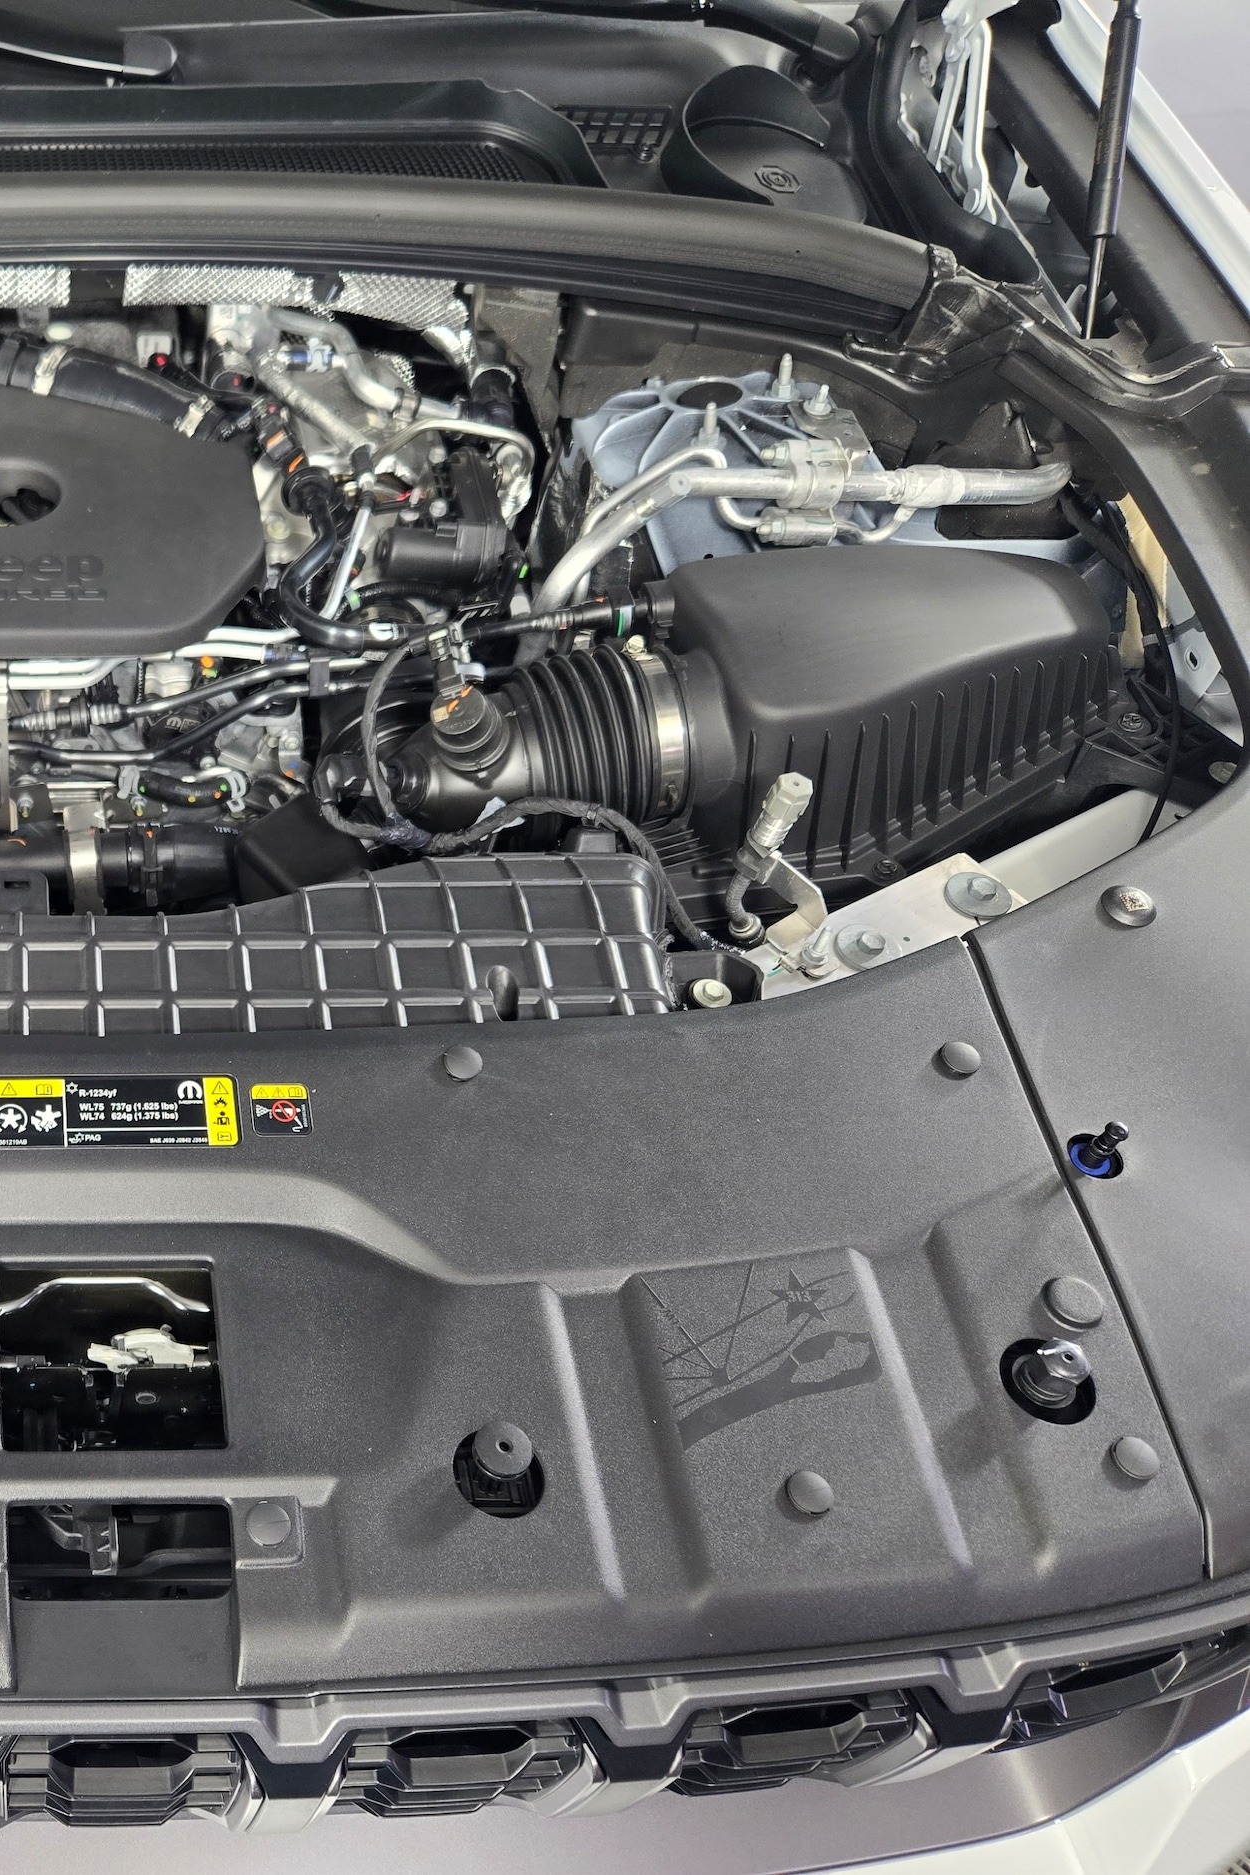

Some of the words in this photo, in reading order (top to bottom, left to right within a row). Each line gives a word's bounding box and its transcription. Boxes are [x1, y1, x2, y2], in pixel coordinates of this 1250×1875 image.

[79, 1089, 117, 1098] R-1234yf
[79, 1103, 105, 1111] WL75
[110, 1102, 132, 1112] 737g
[133, 1102, 160, 1112] (1.625
[161, 1102, 179, 1112] lbs)
[111, 1112, 133, 1122] 624g
[134, 1111, 161, 1121] (1.375
[162, 1111, 180, 1121] lbs)
[84, 1134, 102, 1142] PAG
